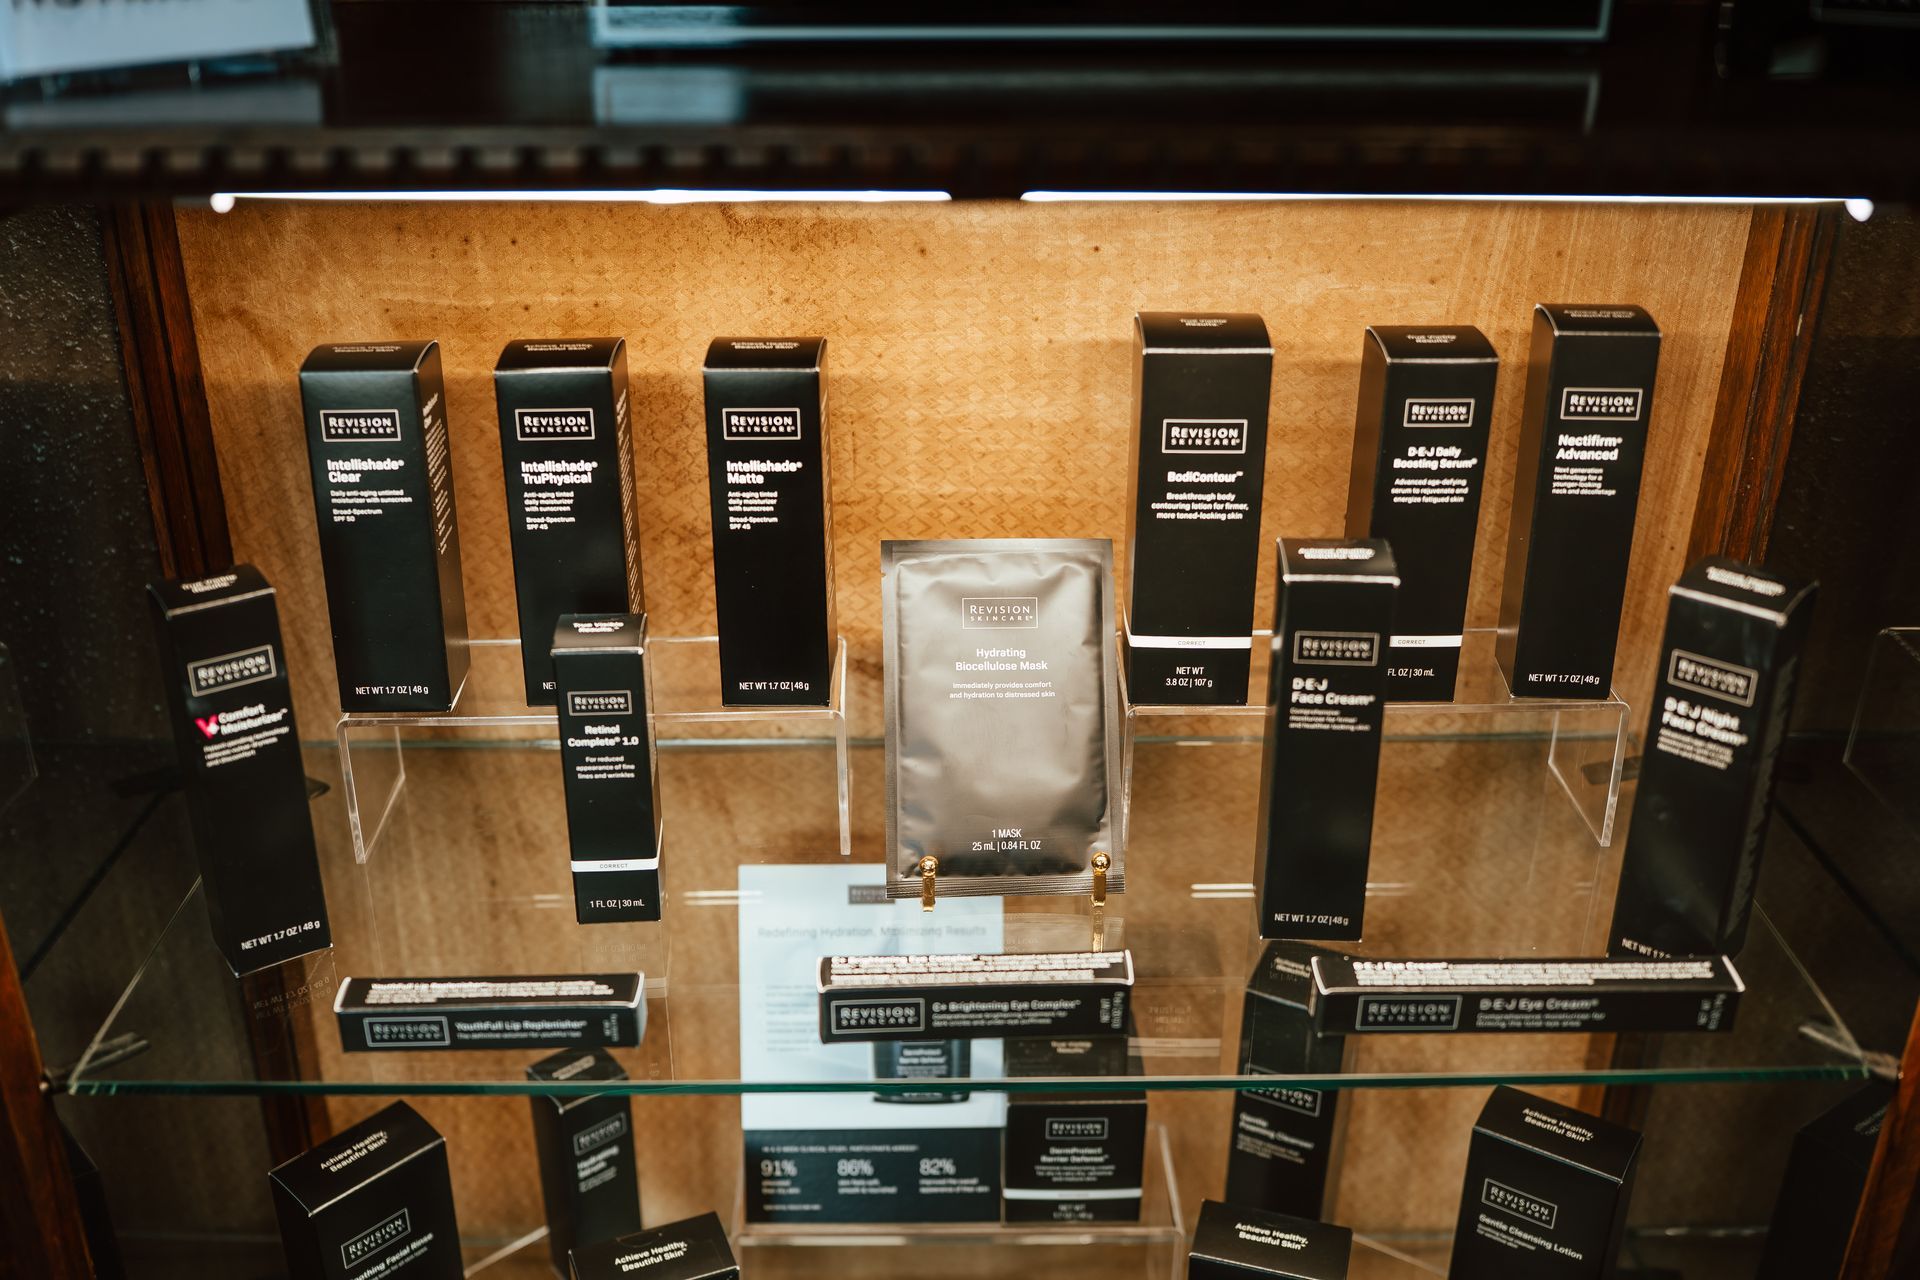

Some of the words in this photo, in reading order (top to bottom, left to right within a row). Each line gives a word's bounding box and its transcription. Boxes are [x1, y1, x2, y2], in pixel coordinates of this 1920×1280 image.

[1570, 394, 1634, 408] REVISION
[1411, 404, 1467, 415] REVISION
[328, 416, 392, 428] REVISION
[524, 416, 586, 427] REVISION
[730, 415, 792, 426] REVISION
[1171, 426, 1239, 438] REVISION
[1436, 446, 1462, 458] Daily
[1556, 448, 1618, 461] Advanced
[1393, 458, 1438, 470] Boosting
[328, 471, 361, 482] Clear
[521, 472, 592, 486] TruPhysical
[727, 472, 764, 484] Matte
[1394, 478, 1426, 486] Advanced
[1427, 478, 1467, 488] age-defying
[1166, 492, 1216, 502] Breakthrough
[1216, 492, 1236, 502] body
[1151, 502, 1190, 511] contouring
[1191, 502, 1213, 510] lotion
[1214, 502, 1224, 510] for
[1176, 512, 1226, 521] toned-looking
[1226, 511, 1244, 520] skin
[970, 604, 1030, 614] REVISION
[976, 648, 1026, 659] Hydrating
[956, 662, 1017, 671] Biocellulose
[1020, 660, 1048, 670] Mask
[1176, 666, 1191, 674] NET
[1192, 666, 1204, 674] WT
[1388, 668, 1396, 677] FL
[1398, 668, 1408, 677] OZ
[1413, 668, 1422, 676] 30
[1424, 668, 1434, 676] mL
[1166, 678, 1177, 686] 3.8
[1178, 678, 1188, 686] OZ
[1194, 678, 1206, 686] 107
[1207, 679, 1213, 688] g
[1528, 674, 1543, 682] NET
[1545, 674, 1558, 682] WT
[1570, 674, 1580, 683] OZ
[1584, 675, 1594, 684] 48
[1594, 676, 1600, 685] g
[356, 686, 370, 694] NET
[371, 686, 384, 694] WT
[385, 686, 396, 694] 1.7
[397, 686, 408, 694] OZ
[412, 685, 422, 694] 48
[423, 686, 428, 694] g
[739, 682, 753, 690] NET
[804, 682, 810, 690] g
[574, 696, 626, 706] REVISION
[964, 692, 995, 700] hydration
[1291, 691, 1324, 704] Face
[584, 724, 620, 735] Retinol
[622, 736, 639, 746] 1.0
[576, 764, 614, 772] appearance
[992, 829, 996, 838] 1
[998, 828, 1022, 838] MASK
[972, 842, 982, 850] 25
[984, 842, 996, 850] mL
[1001, 841, 1018, 850] 0.84
[1020, 840, 1028, 850] FL
[1030, 840, 1041, 850] OZ
[596, 900, 605, 908] FL
[1274, 913, 1290, 922] NET
[1292, 914, 1304, 922] WT
[1306, 915, 1316, 923] 1.7
[1318, 916, 1328, 924] OZ
[1332, 916, 1342, 924] 48
[1343, 918, 1349, 926] g
[241, 938, 258, 950] NET
[258, 934, 272, 946] WT
[274, 930, 285, 940] 1.7
[286, 926, 298, 936] OZ
[303, 922, 314, 930] 48
[314, 920, 320, 928] g
[758, 926, 818, 938] Redefining
[944, 926, 986, 936] Results
[1010, 1000, 1030, 1012] Eye
[840, 1006, 916, 1019] REVISION
[1522, 1108, 1558, 1124] Achieve
[1558, 1120, 1594, 1139] Healthy,
[1524, 1116, 1565, 1135] Beautiful
[320, 1149, 352, 1170] Achieve
[329, 1148, 368, 1173] Beautiful
[760, 1159, 798, 1178] 91%
[919, 1158, 956, 1176] 82%
[1490, 1186, 1550, 1216] REVISION
[1235, 1222, 1271, 1236] Achieve
[1272, 1230, 1309, 1245] Healthy,
[1239, 1232, 1280, 1246] Beautiful
[1478, 1213, 1508, 1232] Gentle
[1508, 1225, 1553, 1250] Cleansing
[1554, 1242, 1583, 1260] Lotion
[386, 1247, 410, 1266] Facial
[410, 1232, 434, 1254] Rinse
[614, 1250, 650, 1266] Achieve
[650, 1241, 688, 1256] Healthy,
[622, 1256, 663, 1272] Beautiful
